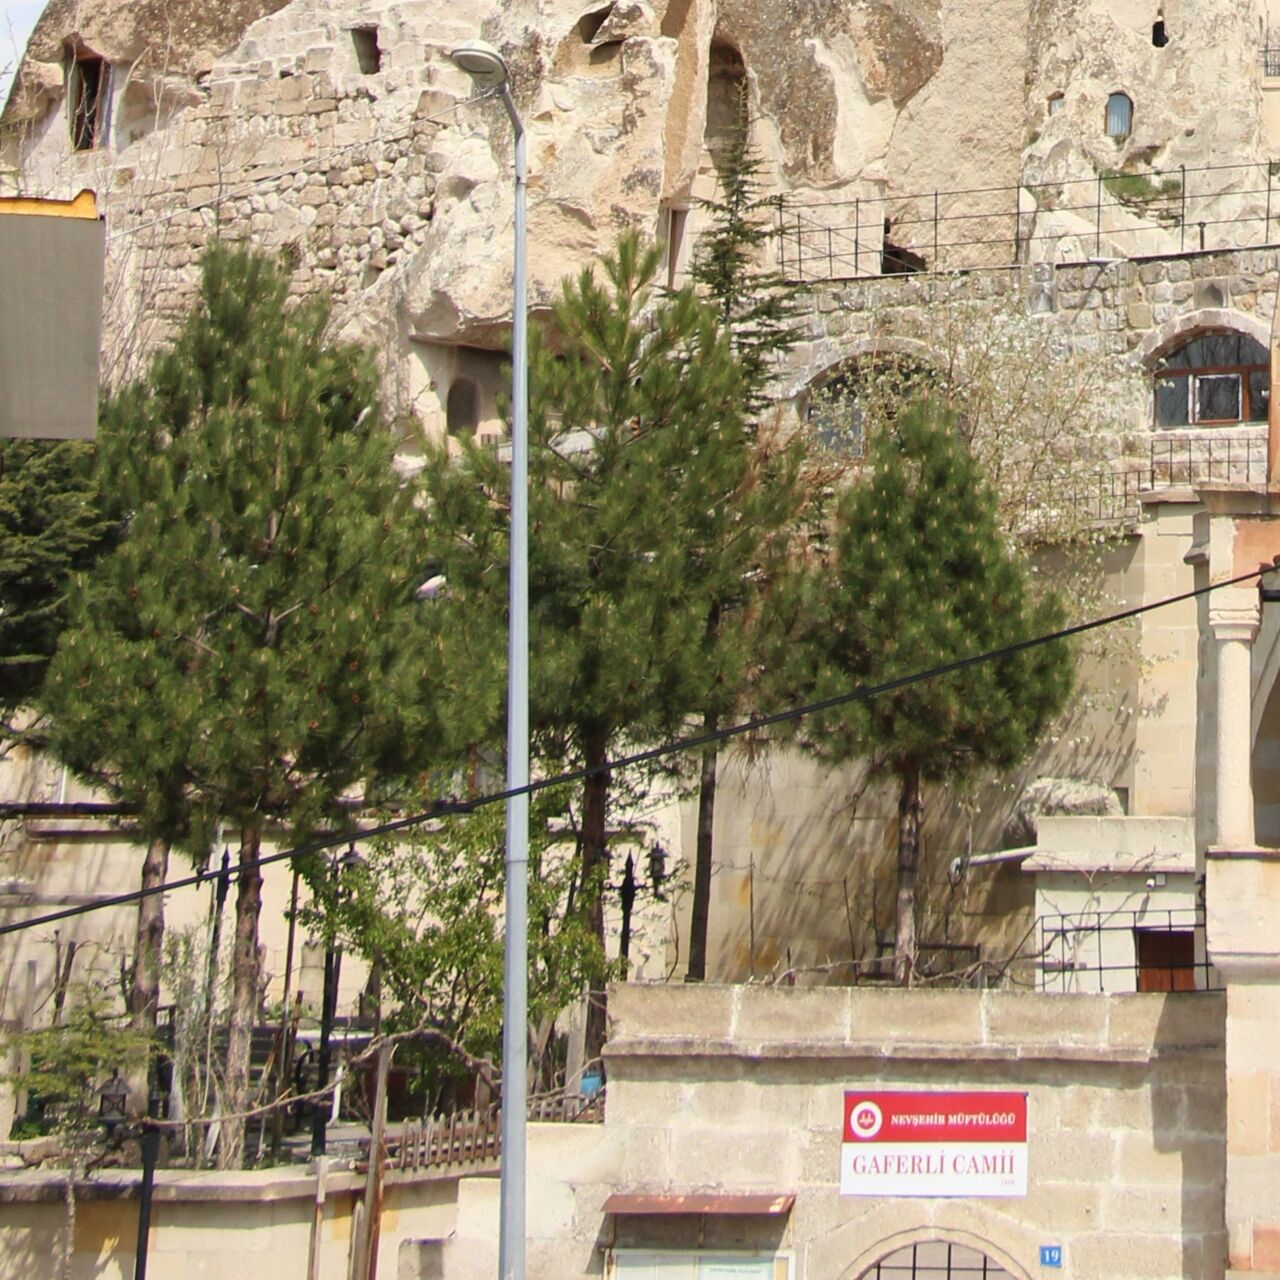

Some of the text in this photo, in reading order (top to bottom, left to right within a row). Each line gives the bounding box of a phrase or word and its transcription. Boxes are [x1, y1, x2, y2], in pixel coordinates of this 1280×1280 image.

[890, 1112, 1016, 1126] NEVŞEHİR MÜFTÜLÜĞÜ
[852, 1150, 1015, 1175] GAFERLİ CAMİİ
[1044, 1249, 1060, 1262] 19
